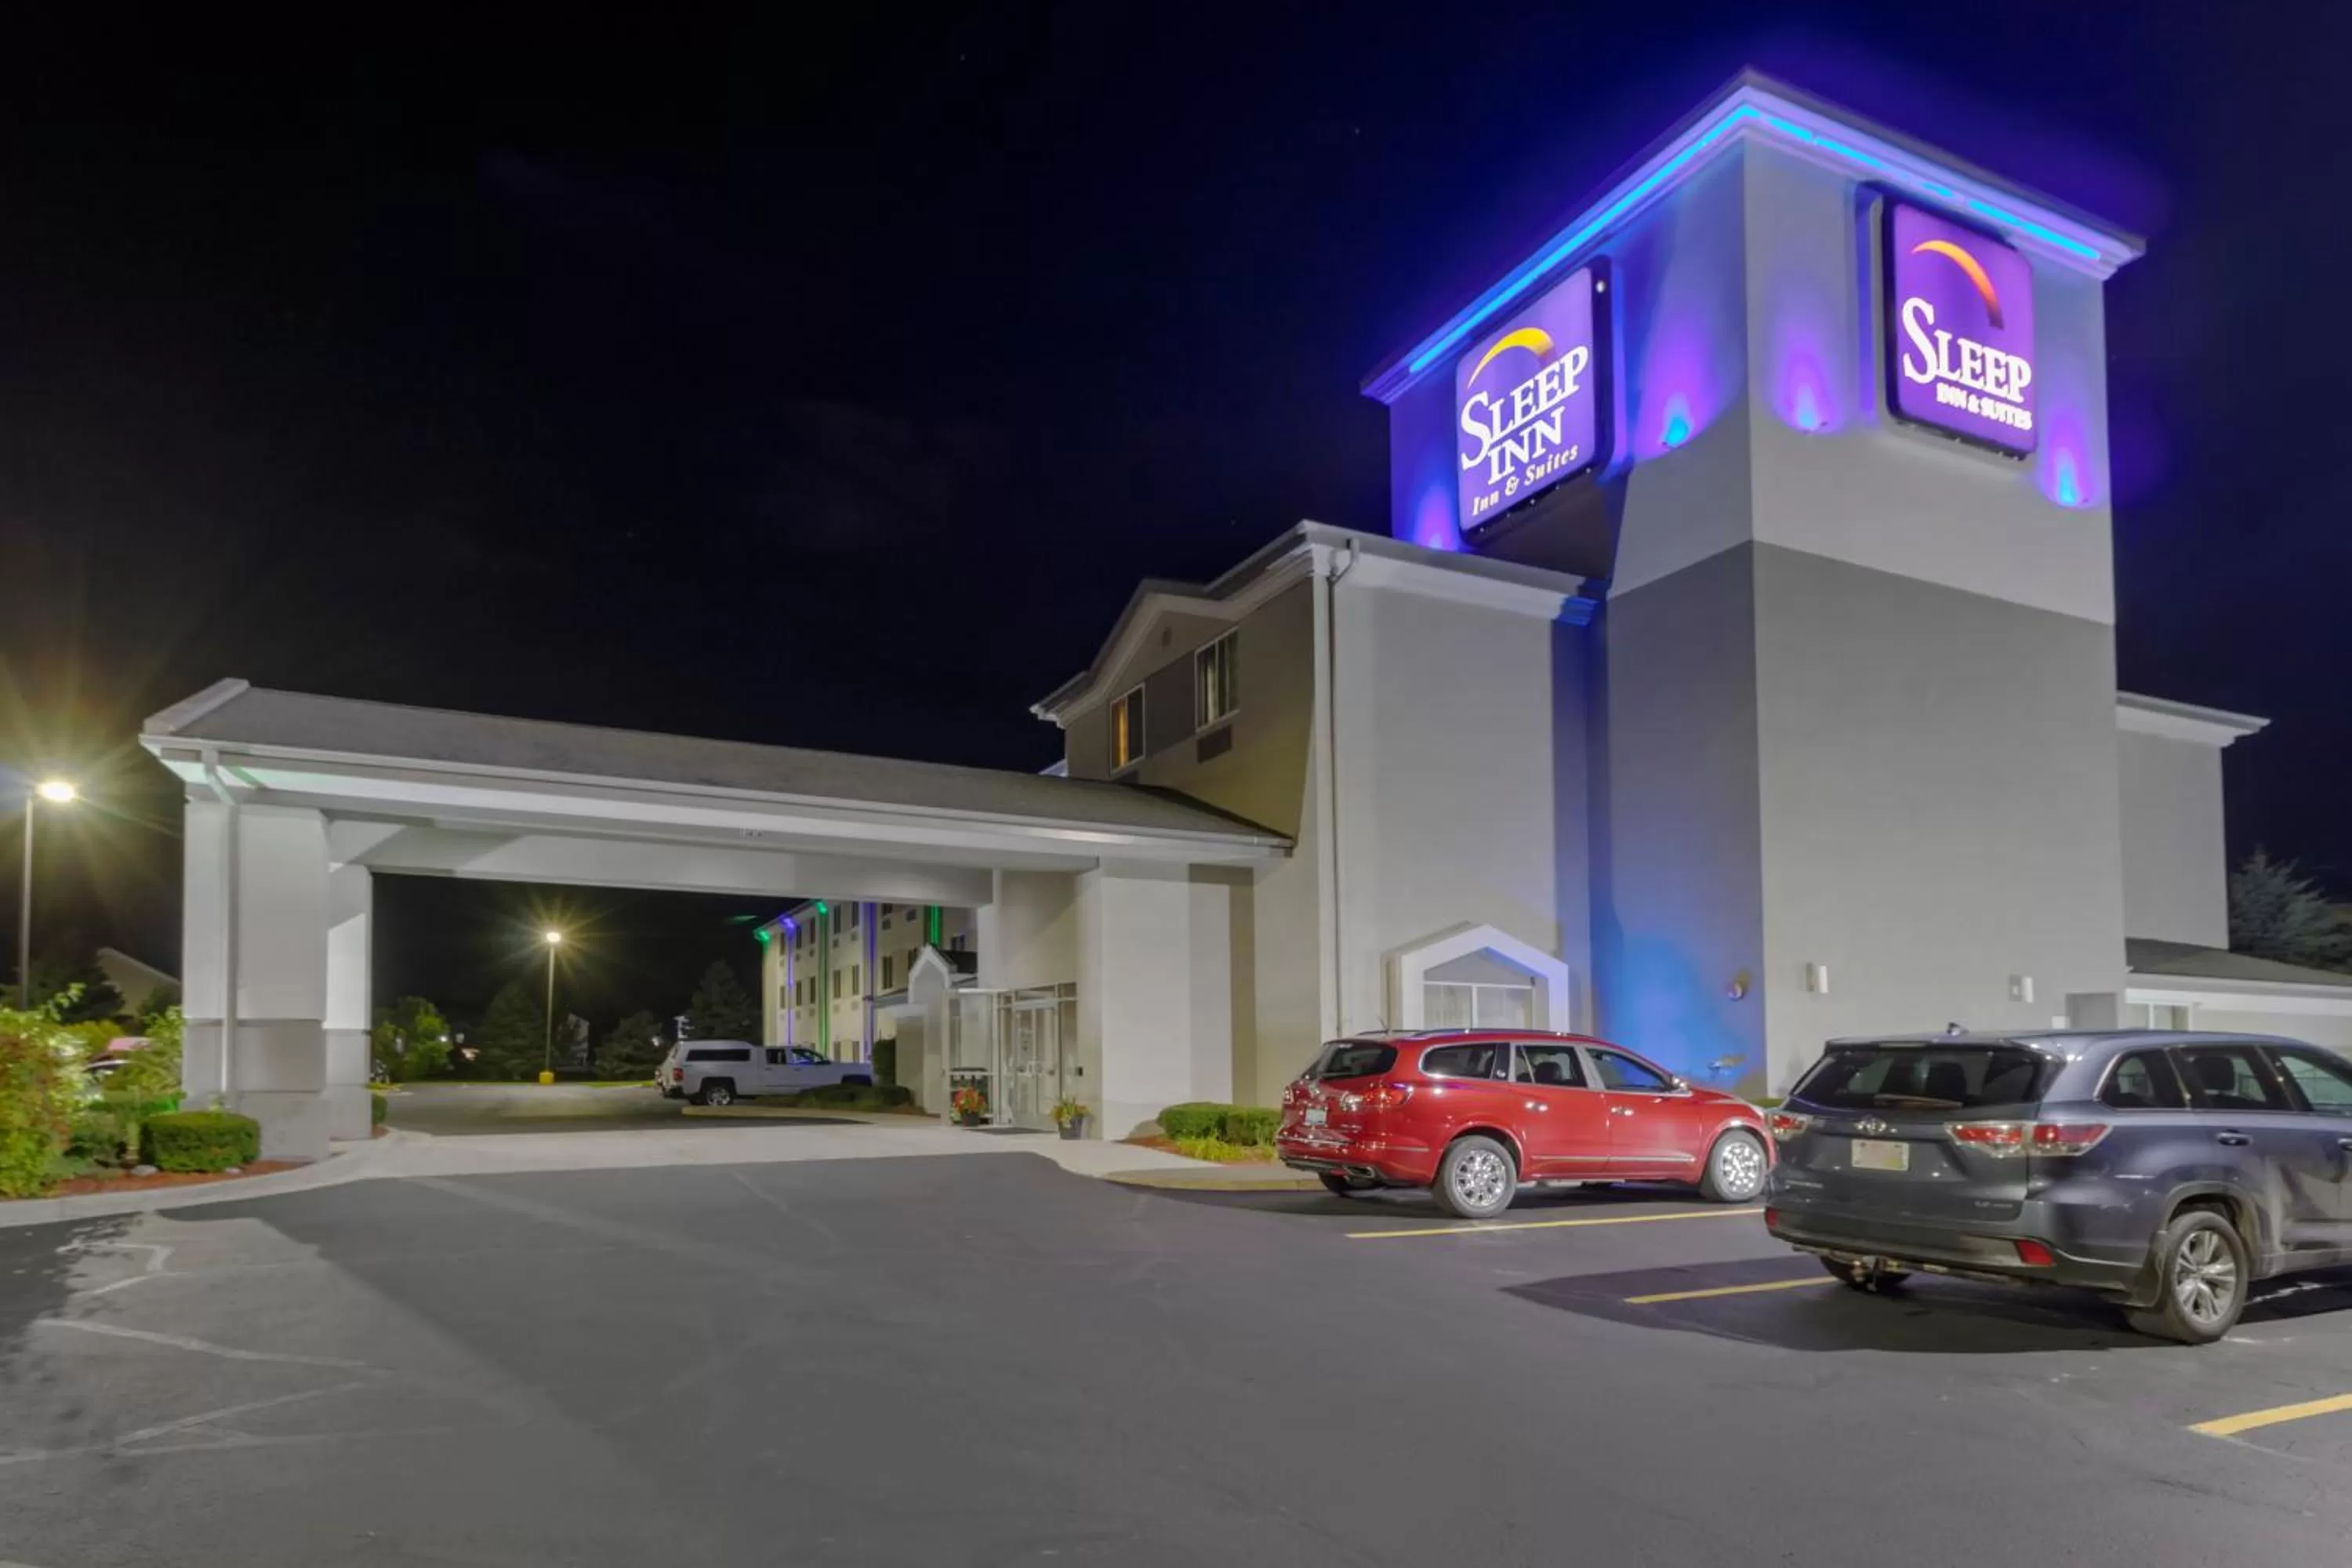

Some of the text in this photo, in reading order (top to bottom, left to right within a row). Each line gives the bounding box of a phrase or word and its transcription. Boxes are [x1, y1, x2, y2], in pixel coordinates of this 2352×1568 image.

[1902, 297, 2031, 403] SLEEP
[1461, 346, 1588, 470] SLEEP
[1967, 394, 1980, 415] &
[1472, 445, 1578, 516] Inn & Suites
[1487, 406, 1565, 485] INN
